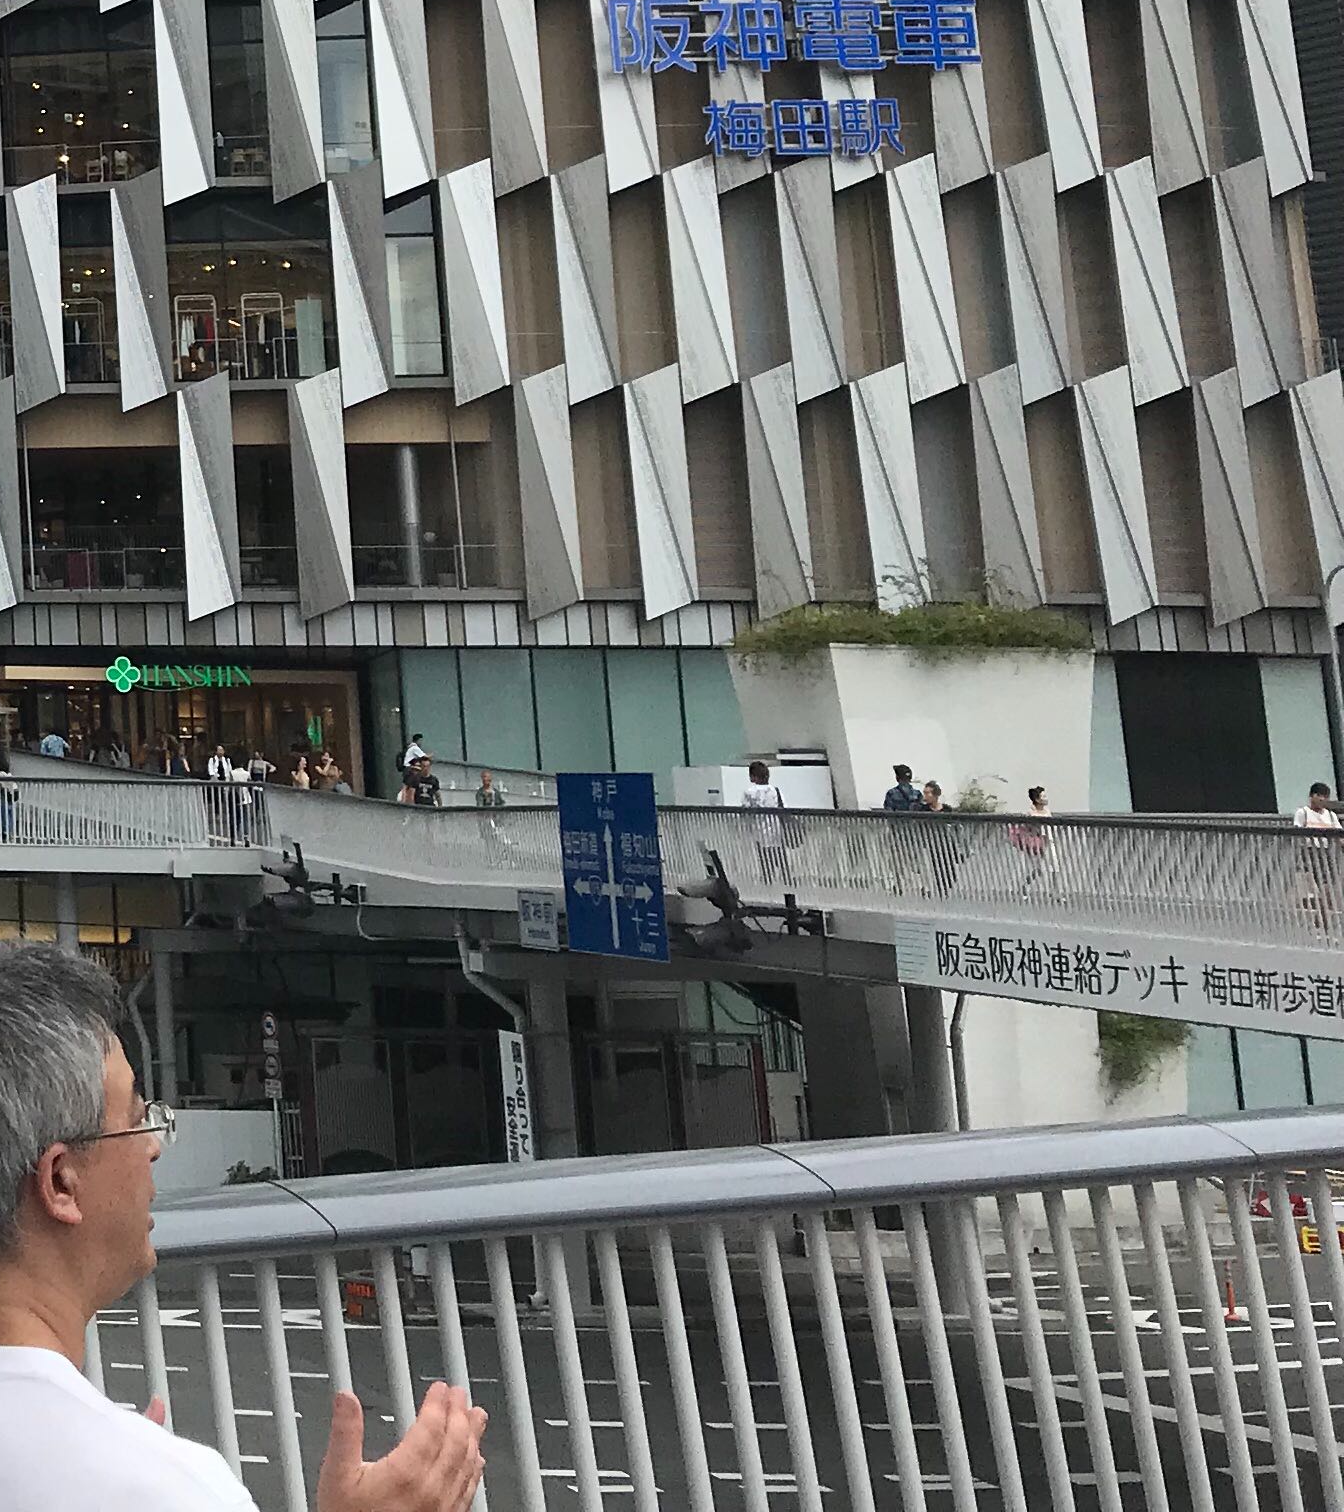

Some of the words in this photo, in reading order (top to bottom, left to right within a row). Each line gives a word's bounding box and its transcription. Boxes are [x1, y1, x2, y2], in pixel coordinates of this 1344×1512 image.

[705, 98, 905, 157] 梅田駅
[141, 664, 252, 687] HANSHIN
[631, 909, 660, 937] 十三
[935, 930, 1189, 1004] 阪急阪神連絡デッキ
